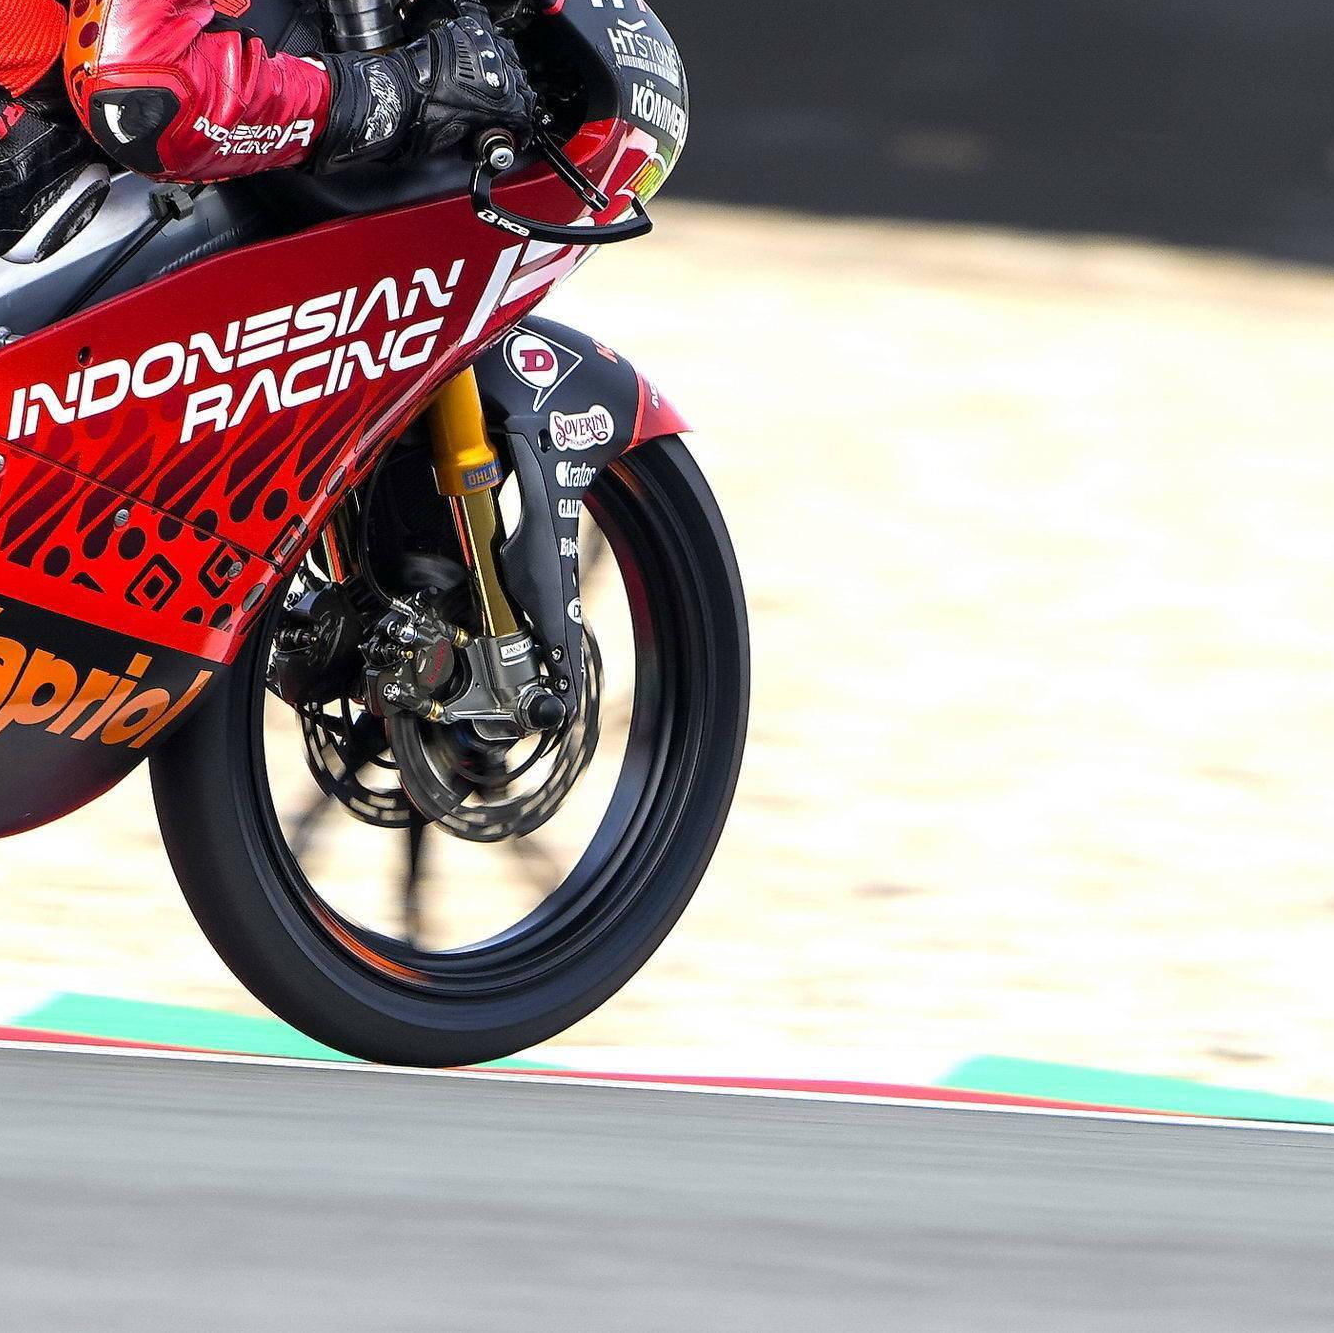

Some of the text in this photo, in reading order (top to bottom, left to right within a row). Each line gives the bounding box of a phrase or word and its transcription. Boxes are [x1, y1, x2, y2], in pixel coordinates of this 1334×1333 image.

[496, 218, 531, 237] RCB
[7, 259, 466, 442] INDONESIAN
[180, 317, 445, 443] RACING
[554, 413, 609, 443] SOVERINI
